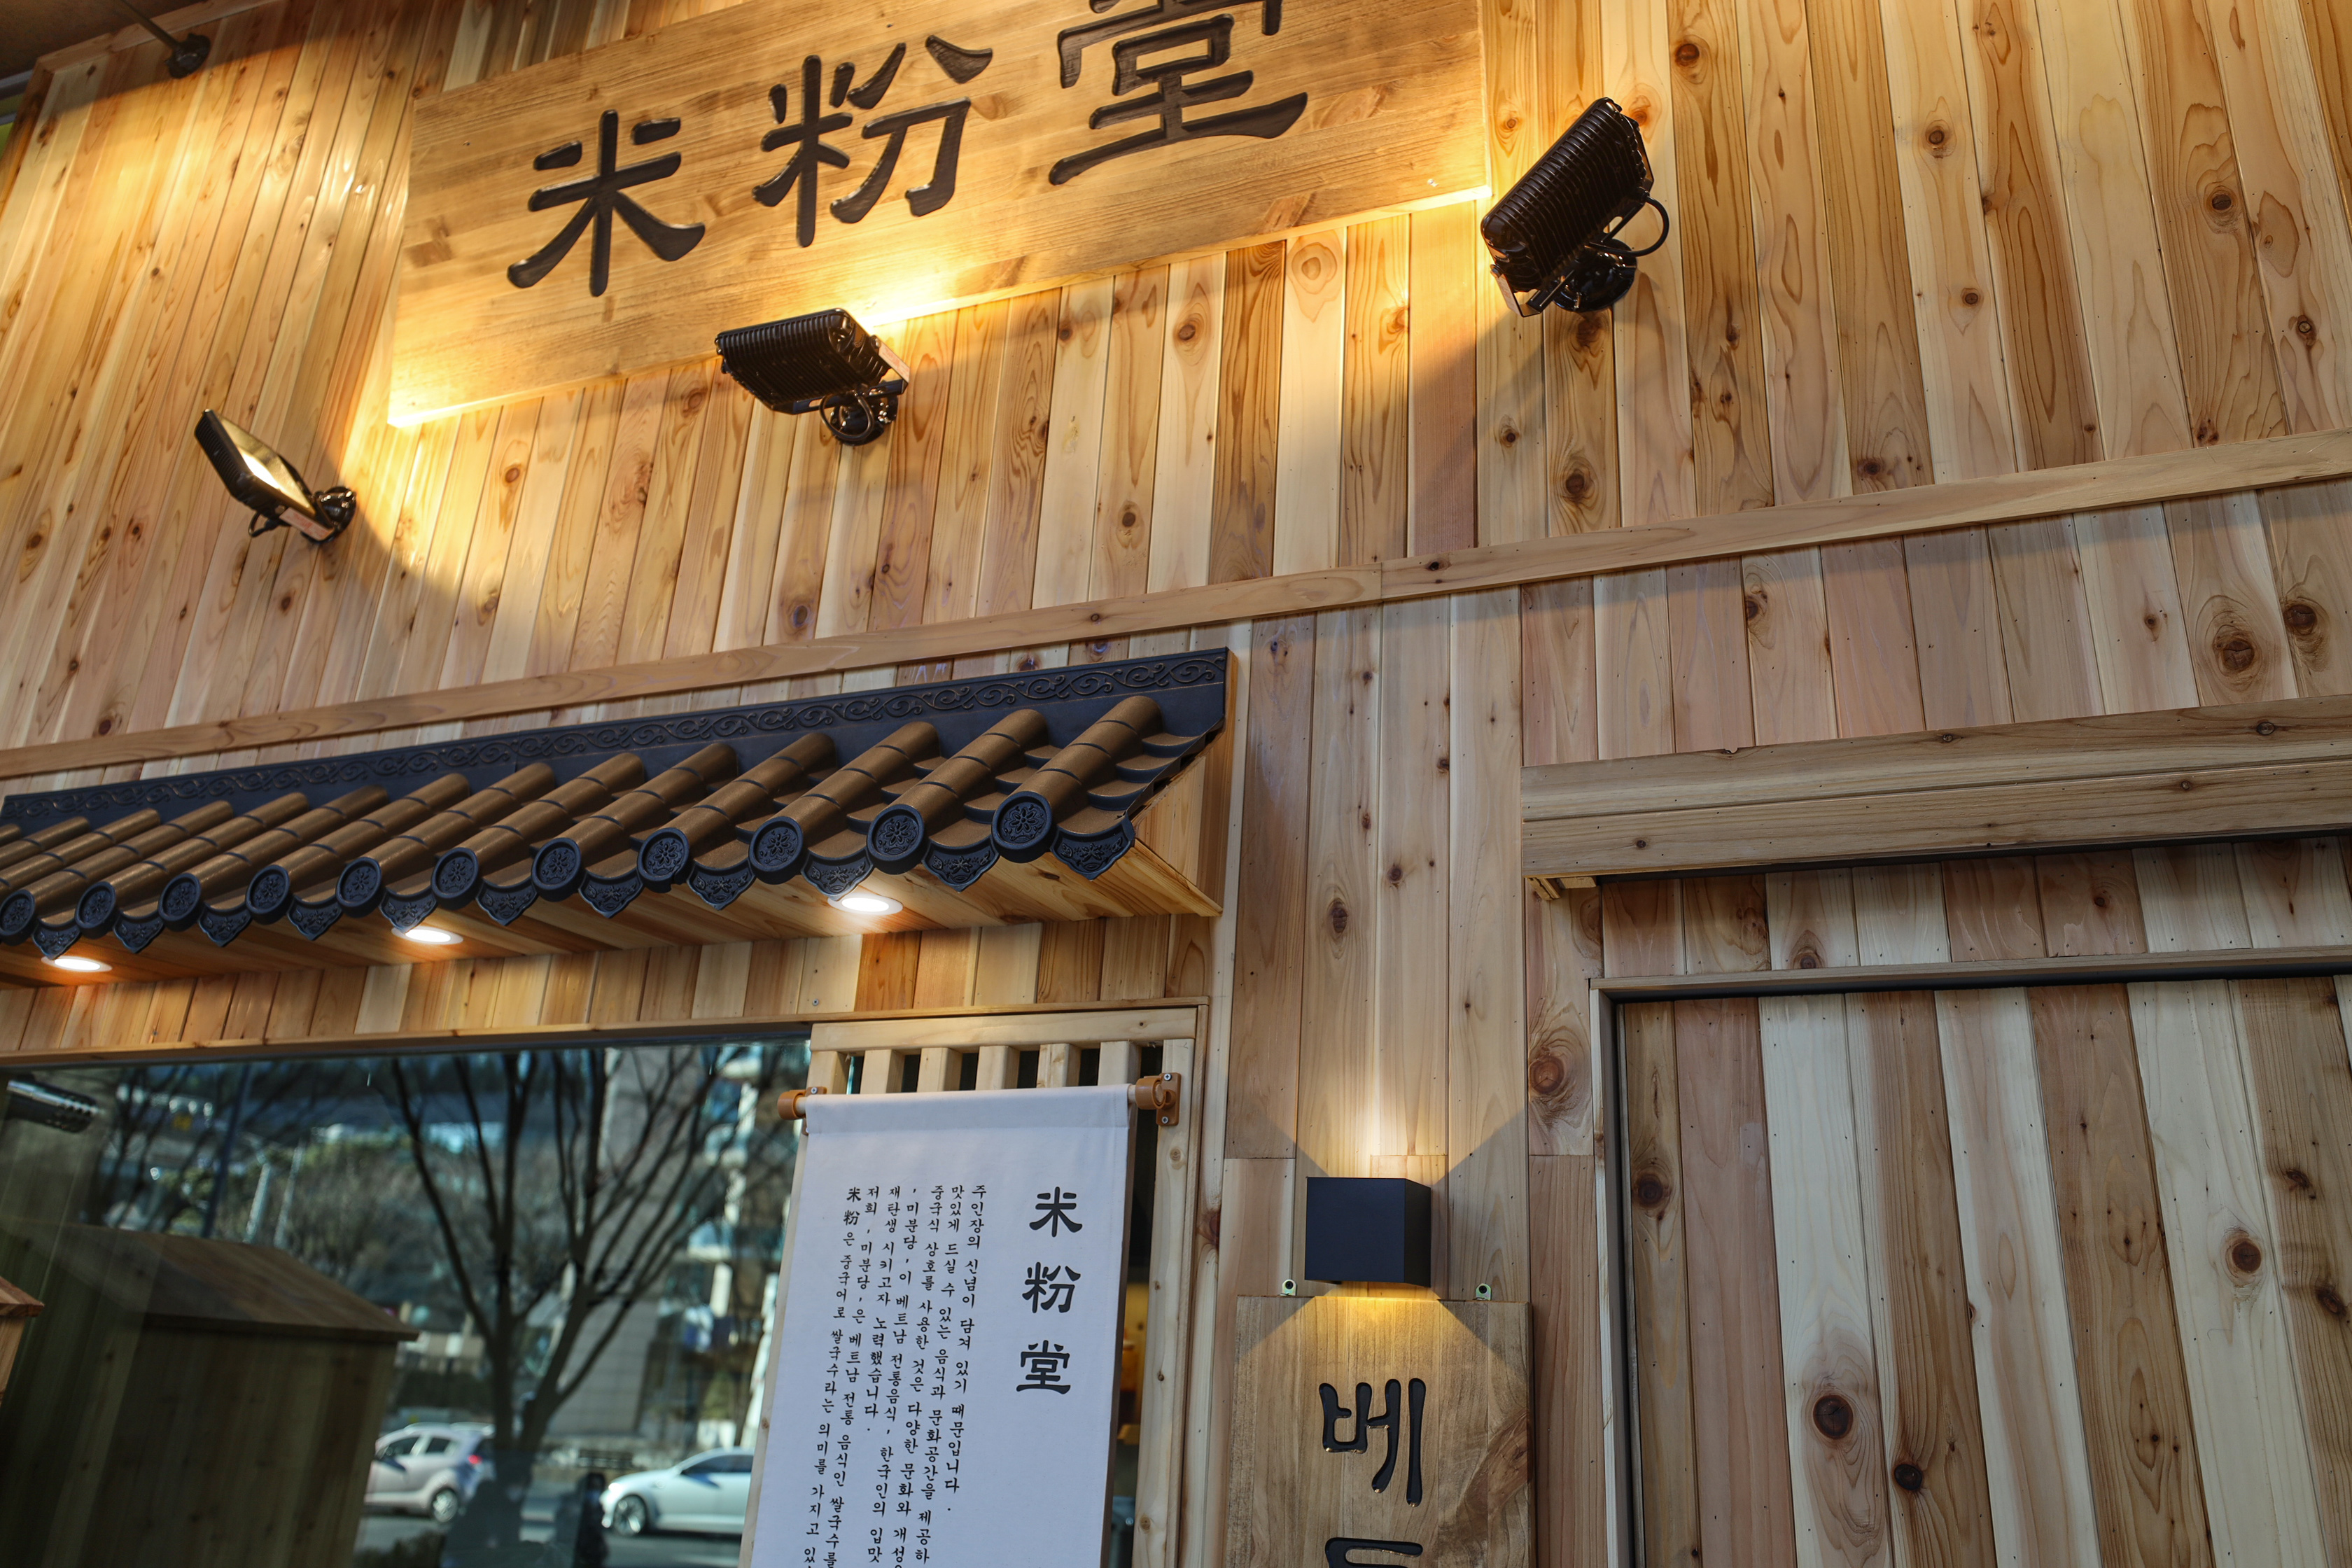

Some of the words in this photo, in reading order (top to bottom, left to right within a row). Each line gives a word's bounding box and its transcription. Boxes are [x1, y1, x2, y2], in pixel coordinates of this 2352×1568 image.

[507, 0, 1308, 297] 米粉堂
[864, 1185, 880, 1216] 저희
[885, 1185, 901, 1233] 재탄생
[927, 1185, 944, 1233] 중국식
[948, 1184, 965, 1233] 맛있게
[967, 1184, 987, 1250] 주인장의
[876, 1241, 895, 1307] 시키고자
[920, 1241, 939, 1292] 상호를
[944, 1243, 959, 1275] 드실
[962, 1259, 979, 1309] 신념이
[832, 1254, 853, 1319] 중국어로
[940, 1282, 955, 1298] 수
[1016, 1186, 1083, 1394] 米粉堂
[892, 1294, 909, 1345] 베트남
[915, 1299, 933, 1350] 사용한
[936, 1306, 951, 1340] 있는
[958, 1317, 975, 1351] 담겨
[821, 1329, 844, 1414] 쌀국수라는
[845, 1332, 862, 1383] 베트남
[909, 1358, 925, 1392] 것은
[930, 1348, 949, 1401] 음식과
[954, 1360, 969, 1394] 있기
[839, 1392, 855, 1426] 전통
[904, 1401, 923, 1455] 다양한
[813, 1422, 830, 1476] 의미를
[833, 1434, 851, 1488] 음식인
[920, 1409, 943, 1501] 문화공간을
[872, 1446, 894, 1518] 한국인의
[895, 1463, 916, 1517] 문화와
[806, 1483, 825, 1535] 가지고
[804, 1546, 816, 1568] 있
[867, 1527, 883, 1564] 입맛
[914, 1509, 932, 1564] 제공하
